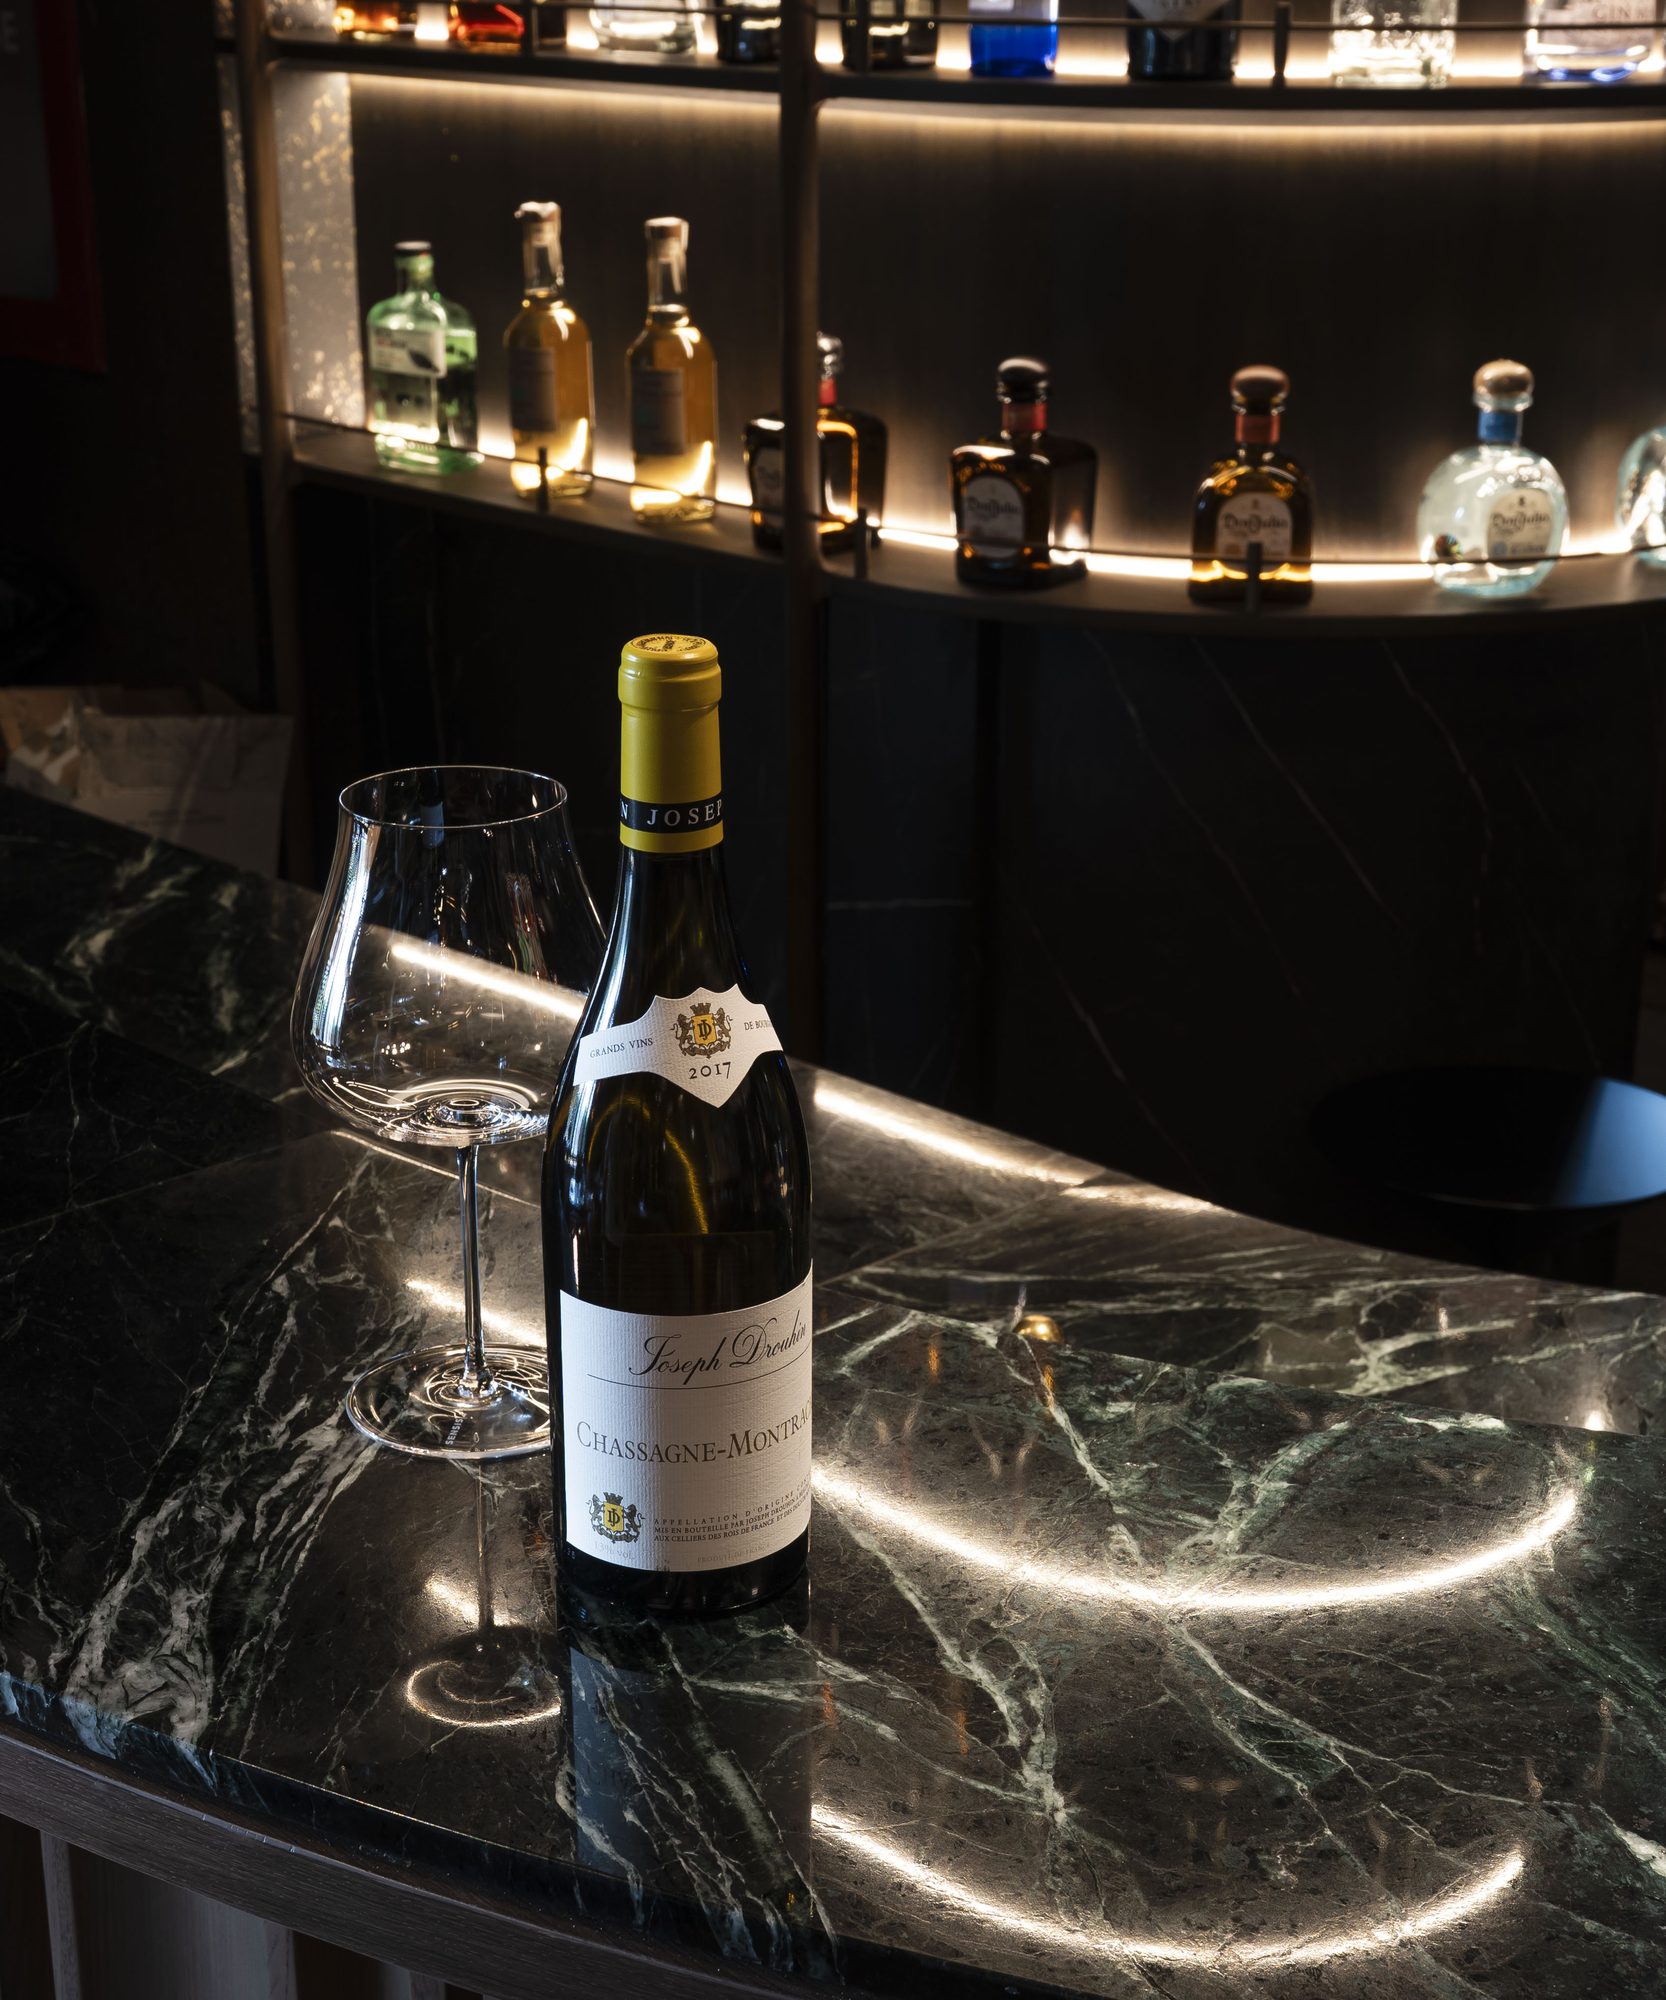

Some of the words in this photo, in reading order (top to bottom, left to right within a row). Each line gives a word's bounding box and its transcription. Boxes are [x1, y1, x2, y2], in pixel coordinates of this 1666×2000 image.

[743, 1021, 754, 1031] DE
[589, 1042, 625, 1059] GRANDS
[629, 1037, 654, 1050] VINS
[688, 1061, 732, 1080] 2017
[628, 1334, 728, 1385] Joseph
[729, 1310, 807, 1369] Drouhin
[653, 1513, 738, 1525] APPELLATION
[654, 1526, 670, 1534] MIS
[684, 1524, 729, 1534] BOUTEILLE
[730, 1520, 745, 1529] PAR
[745, 1512, 770, 1526] JOSEPH
[671, 1534, 707, 1543] CELLIERS
[708, 1533, 722, 1541] DES
[723, 1529, 740, 1538] ROIS
[751, 1518, 775, 1531] FRANCE
